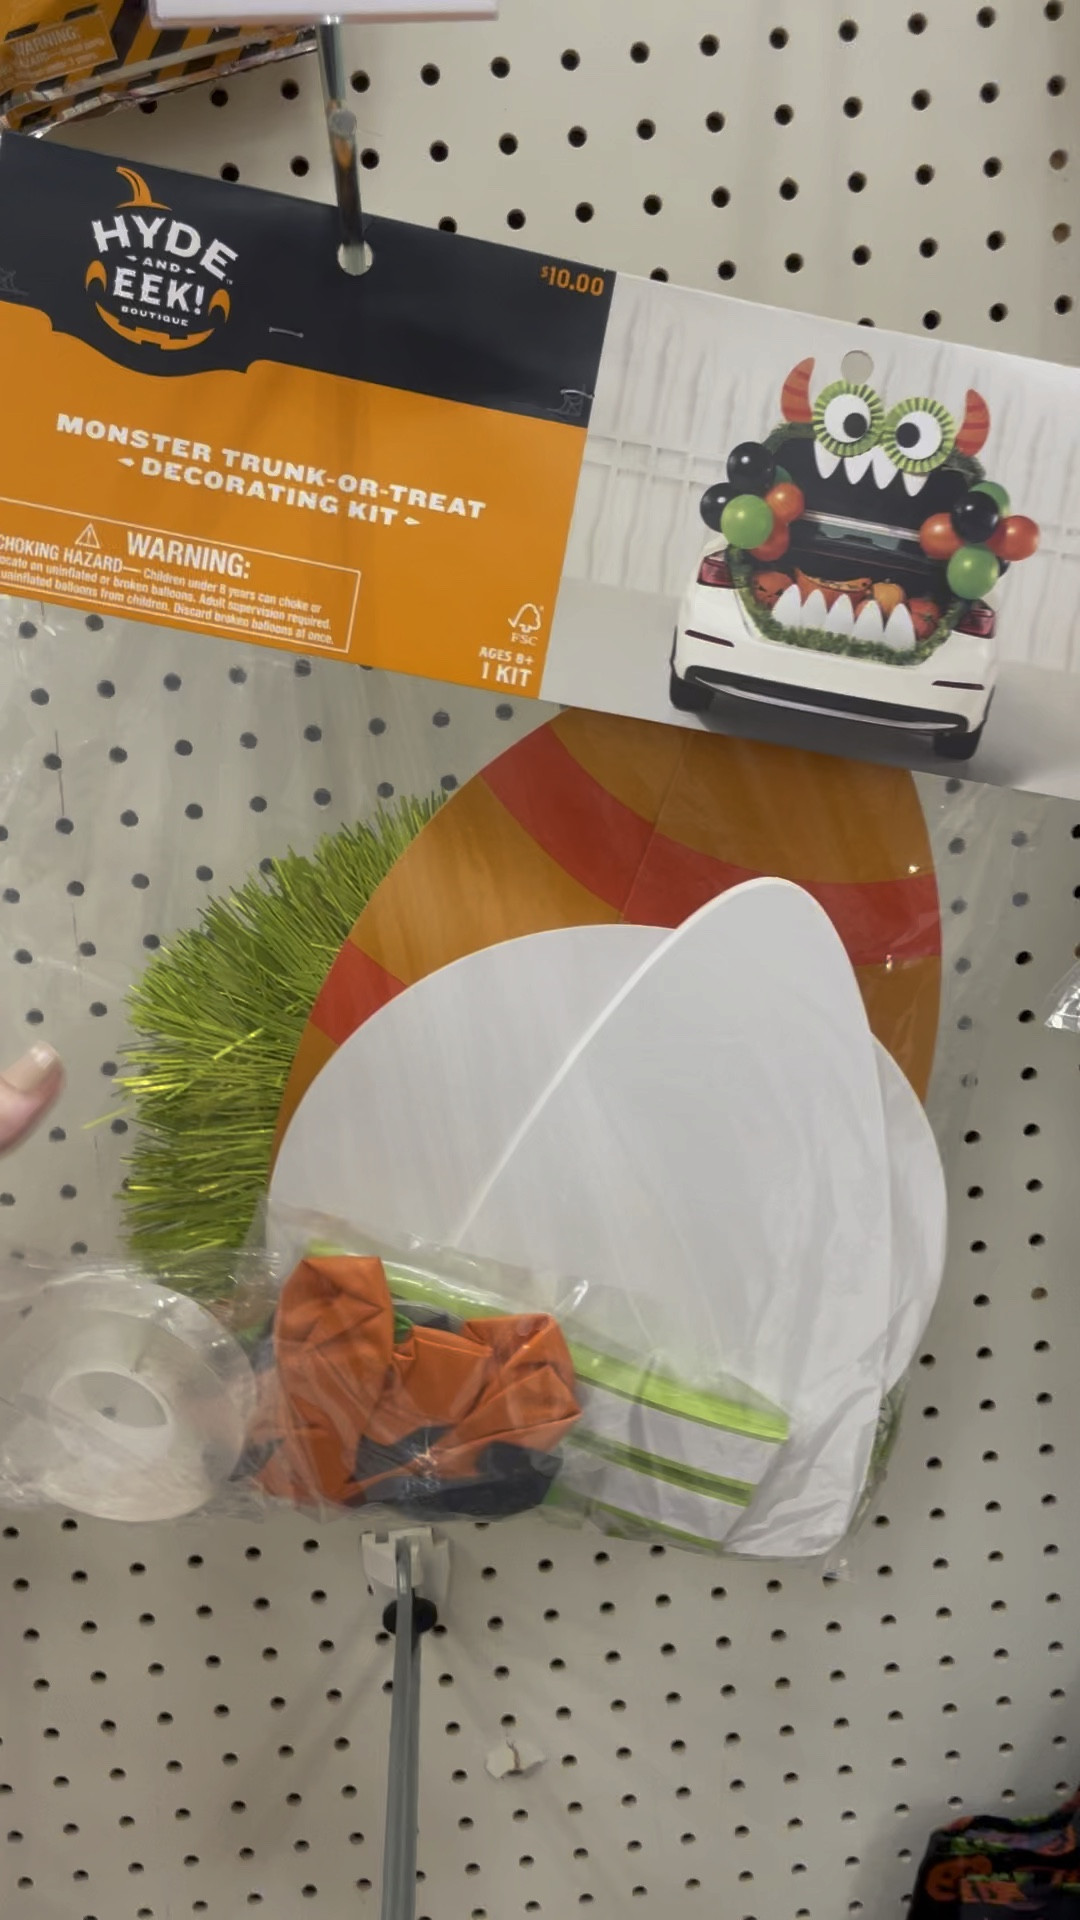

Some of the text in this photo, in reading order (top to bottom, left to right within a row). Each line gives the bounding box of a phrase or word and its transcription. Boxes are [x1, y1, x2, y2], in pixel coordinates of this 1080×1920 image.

[91, 214, 239, 281] HYDE
[142, 257, 181, 274] AND
[113, 266, 205, 315] EEK!
[540, 265, 605, 296] $10.00
[120, 305, 189, 327] BOUTIQUE
[56, 413, 487, 519] MONSTER TRUNK-OR-TREAT
[141, 457, 398, 525] DECORATING KIT
[127, 531, 251, 579] WARNING:
[46, 564, 98, 583] uninflated
[100, 576, 110, 586] or
[113, 575, 149, 593] broken
[199, 593, 226, 609] Adult
[228, 601, 286, 621] supervision
[54, 579, 98, 597] balloons
[100, 588, 125, 603] from
[173, 602, 213, 620] Discard
[214, 610, 249, 627] broken
[251, 618, 294, 637] balloons
[295, 628, 306, 640] at
[144, 568, 186, 587] Children
[188, 579, 218, 593] under
[228, 587, 256, 600] years
[257, 593, 276, 605] can
[279, 596, 309, 612] choke
[310, 603, 322, 614] or
[479, 646, 534, 665] AGES 8+
[511, 632, 538, 646] FSC
[496, 663, 532, 687] KIT
